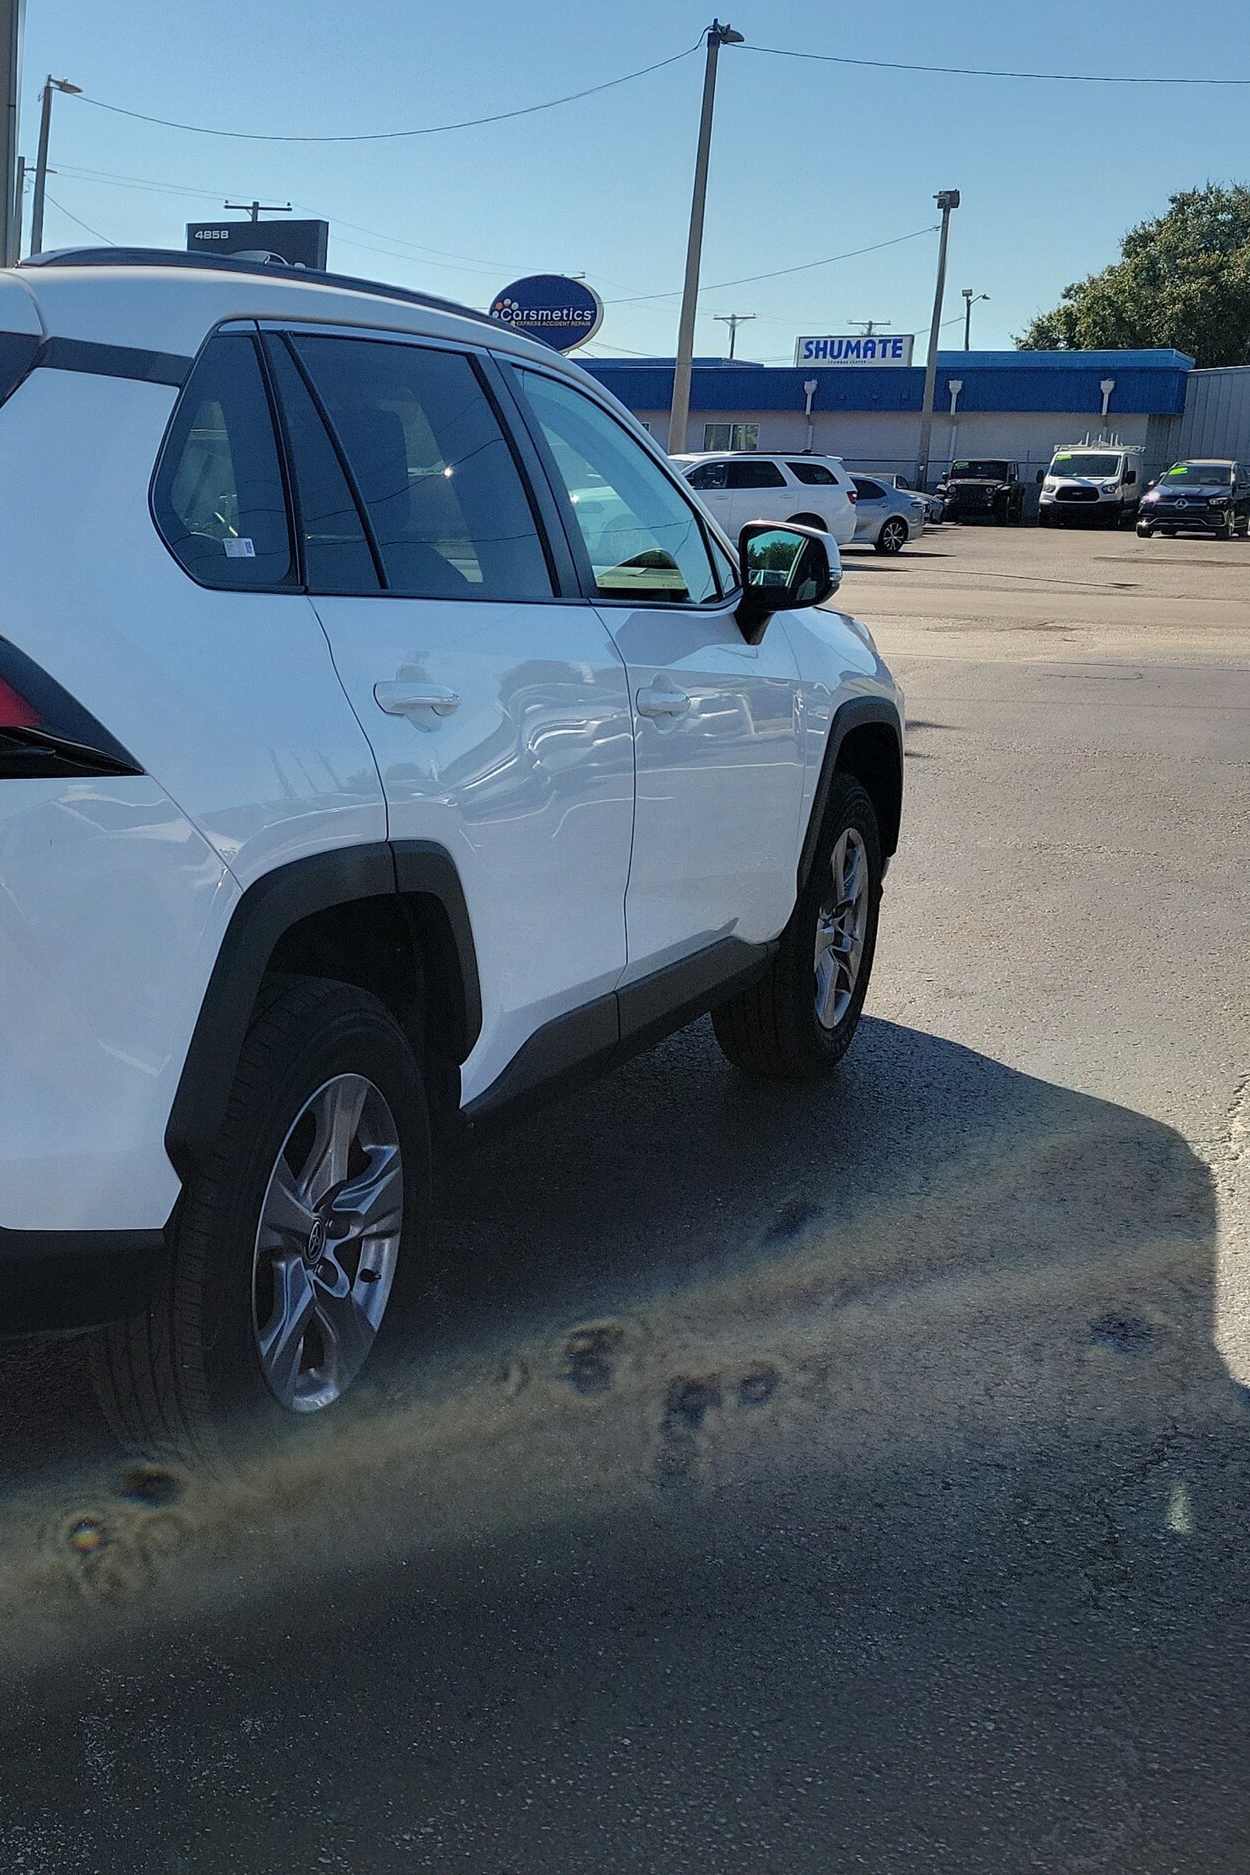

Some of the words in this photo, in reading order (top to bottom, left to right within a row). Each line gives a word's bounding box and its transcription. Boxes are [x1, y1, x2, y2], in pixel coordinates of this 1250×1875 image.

[195, 230, 229, 240] 4858
[500, 307, 592, 321] Carsmetics
[803, 337, 904, 360] SHUMATE
